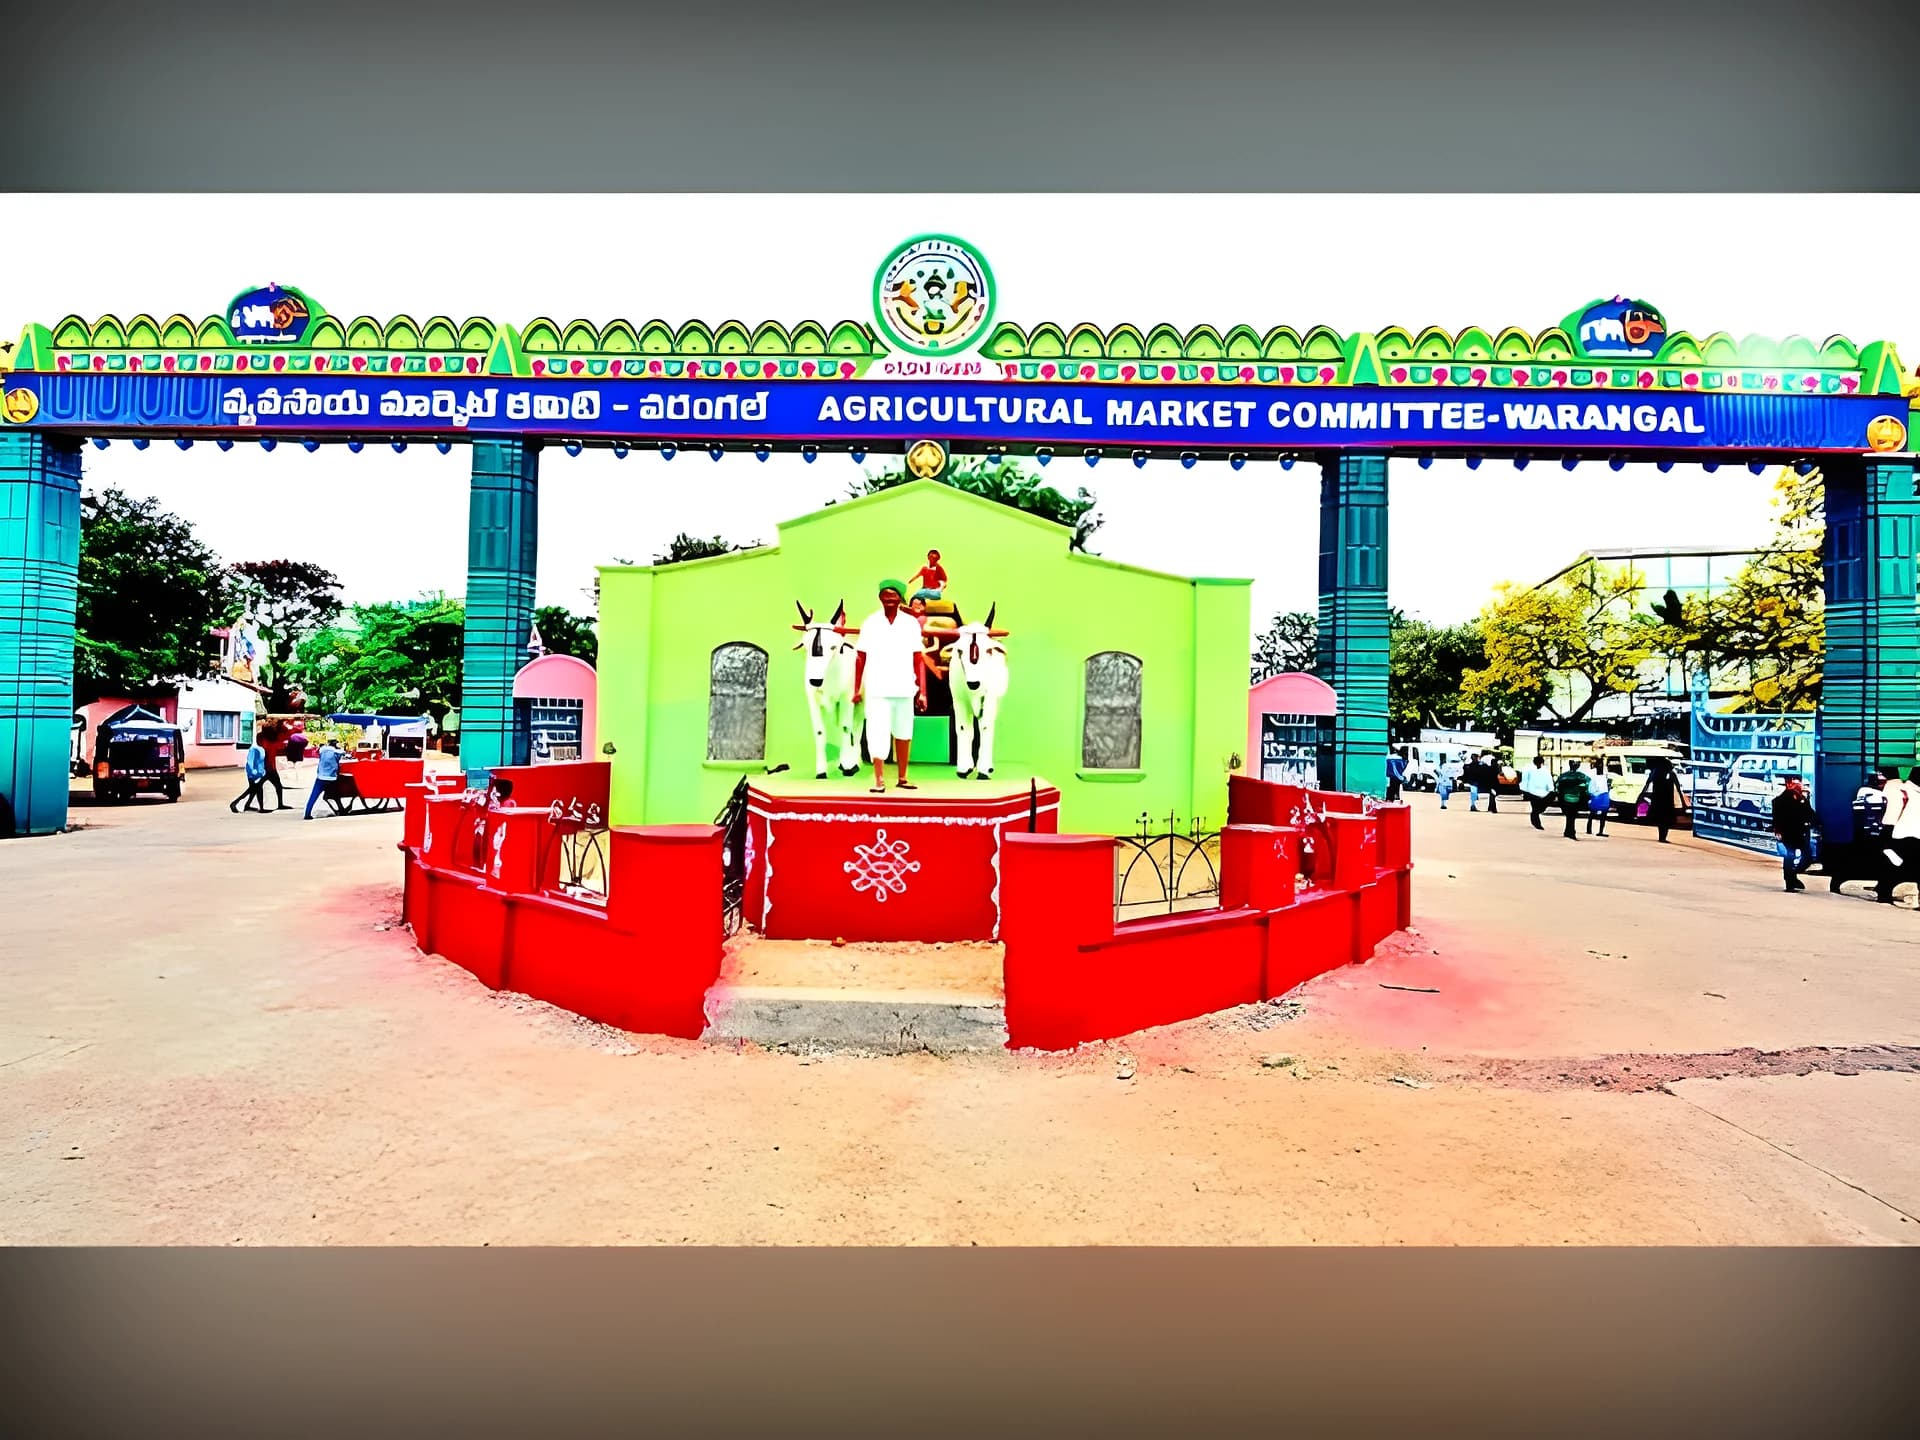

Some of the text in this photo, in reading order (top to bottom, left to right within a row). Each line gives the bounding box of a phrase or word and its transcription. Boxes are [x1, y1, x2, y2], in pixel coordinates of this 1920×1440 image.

[222, 387, 370, 427] వ్యవసాయ
[639, 391, 770, 421] వరంగల్
[817, 395, 1705, 434] AGRICULTURAL MARKET COMMITTEE-WARANGAL
